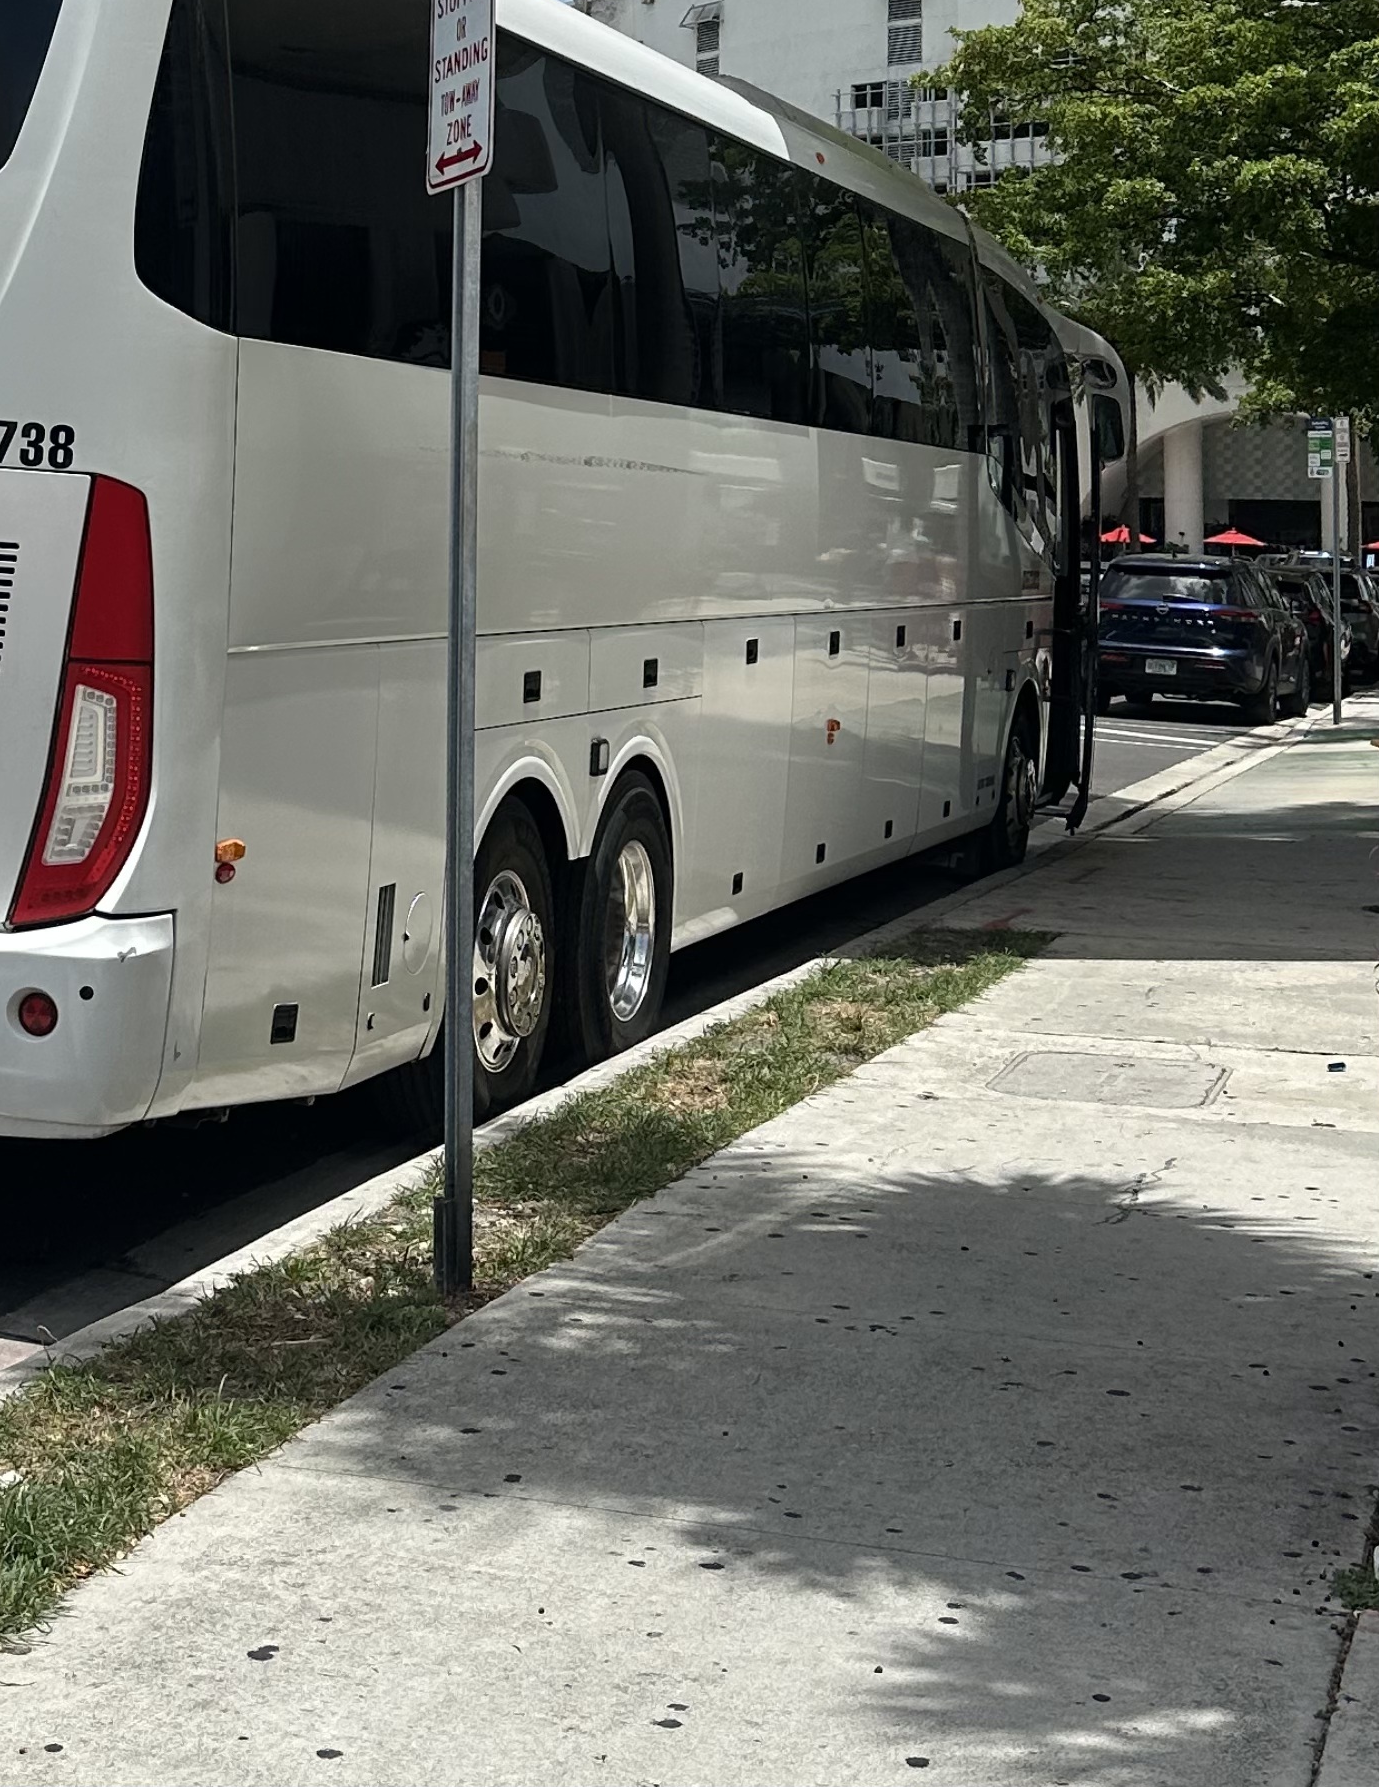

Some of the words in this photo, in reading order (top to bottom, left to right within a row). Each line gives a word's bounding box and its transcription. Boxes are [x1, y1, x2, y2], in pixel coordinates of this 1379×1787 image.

[456, 16, 467, 41] OR
[434, 36, 488, 83] STANDING
[440, 77, 480, 117] TOW-AWAY
[446, 114, 472, 146] ZONE
